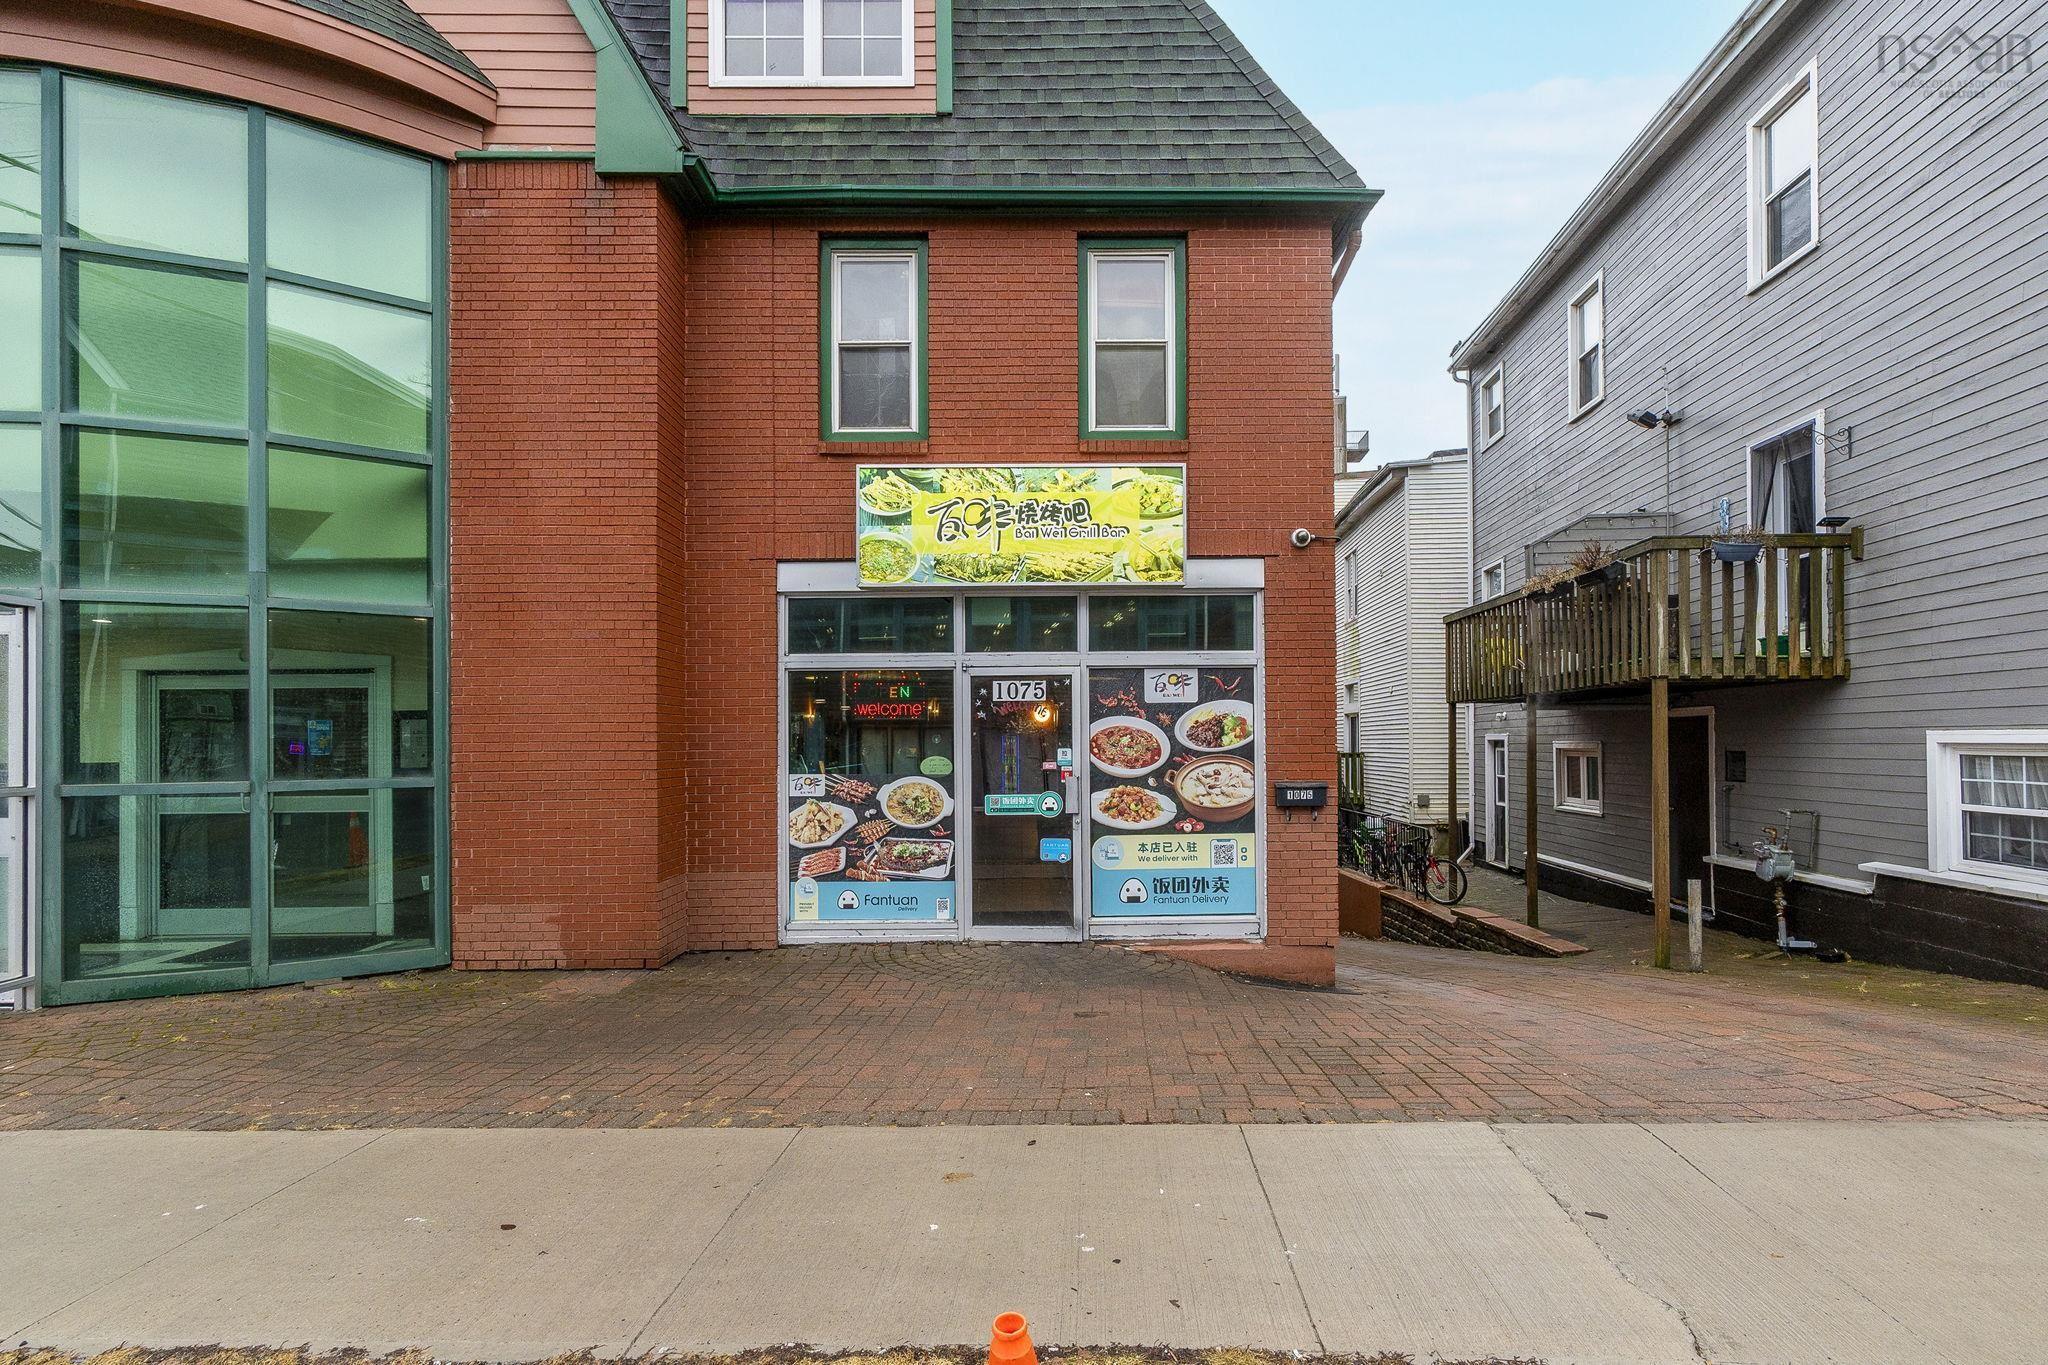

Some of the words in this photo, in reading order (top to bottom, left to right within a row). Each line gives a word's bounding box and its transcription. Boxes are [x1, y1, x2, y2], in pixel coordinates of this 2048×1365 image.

[1015, 525, 1038, 540] Bai
[1041, 526, 1066, 539] Wei
[1068, 525, 1099, 539] Grill
[1101, 525, 1129, 538] Bar
[996, 682, 1045, 700] 1075
[856, 702, 922, 716] welcome
[1288, 790, 1313, 799] 1075
[1137, 842, 1198, 853] 本店已入驻
[1152, 876, 1230, 894] 饭团外卖
[864, 893, 918, 906] Fantuan
[1153, 895, 1190, 904] Fantuan
[1192, 895, 1230, 905] Delivery
